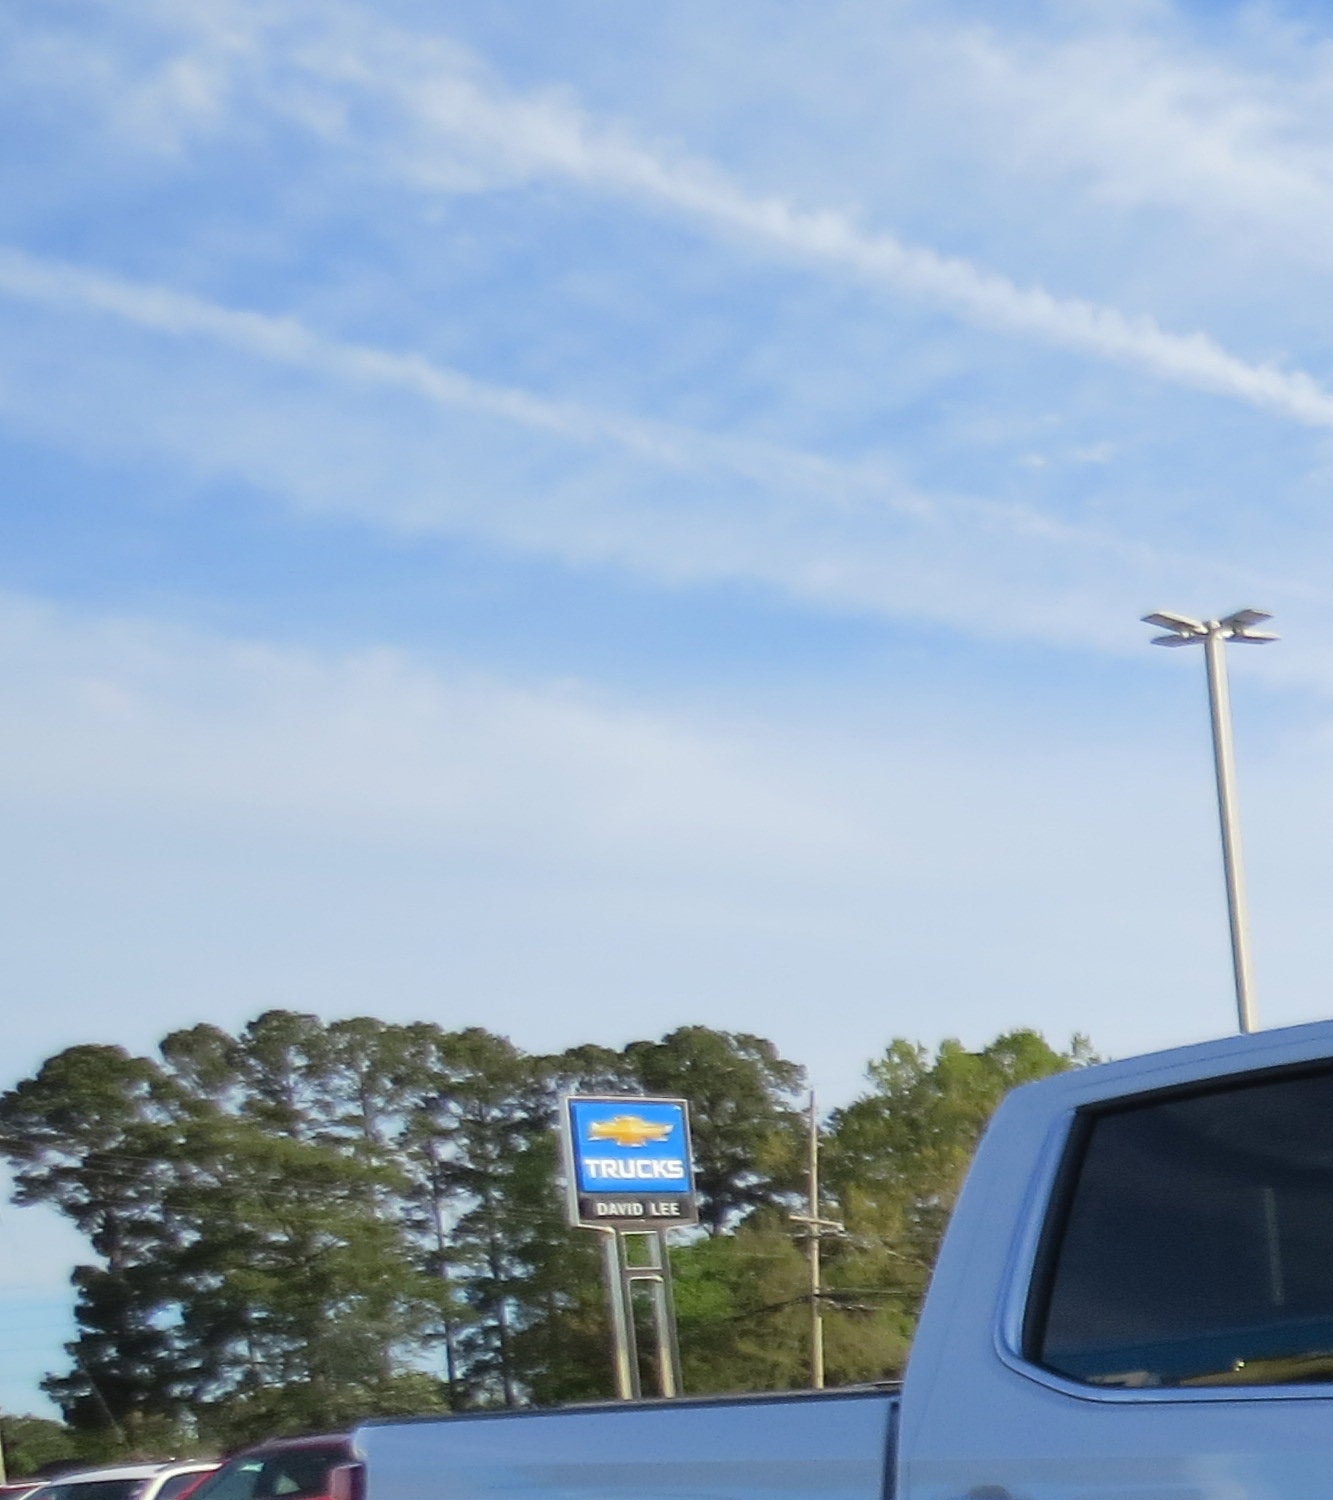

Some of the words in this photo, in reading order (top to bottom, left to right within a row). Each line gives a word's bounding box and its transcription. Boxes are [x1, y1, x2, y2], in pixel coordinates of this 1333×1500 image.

[584, 1159, 684, 1179] TRUCKS
[596, 1202, 643, 1216] DAVID
[651, 1202, 680, 1216] LEE
